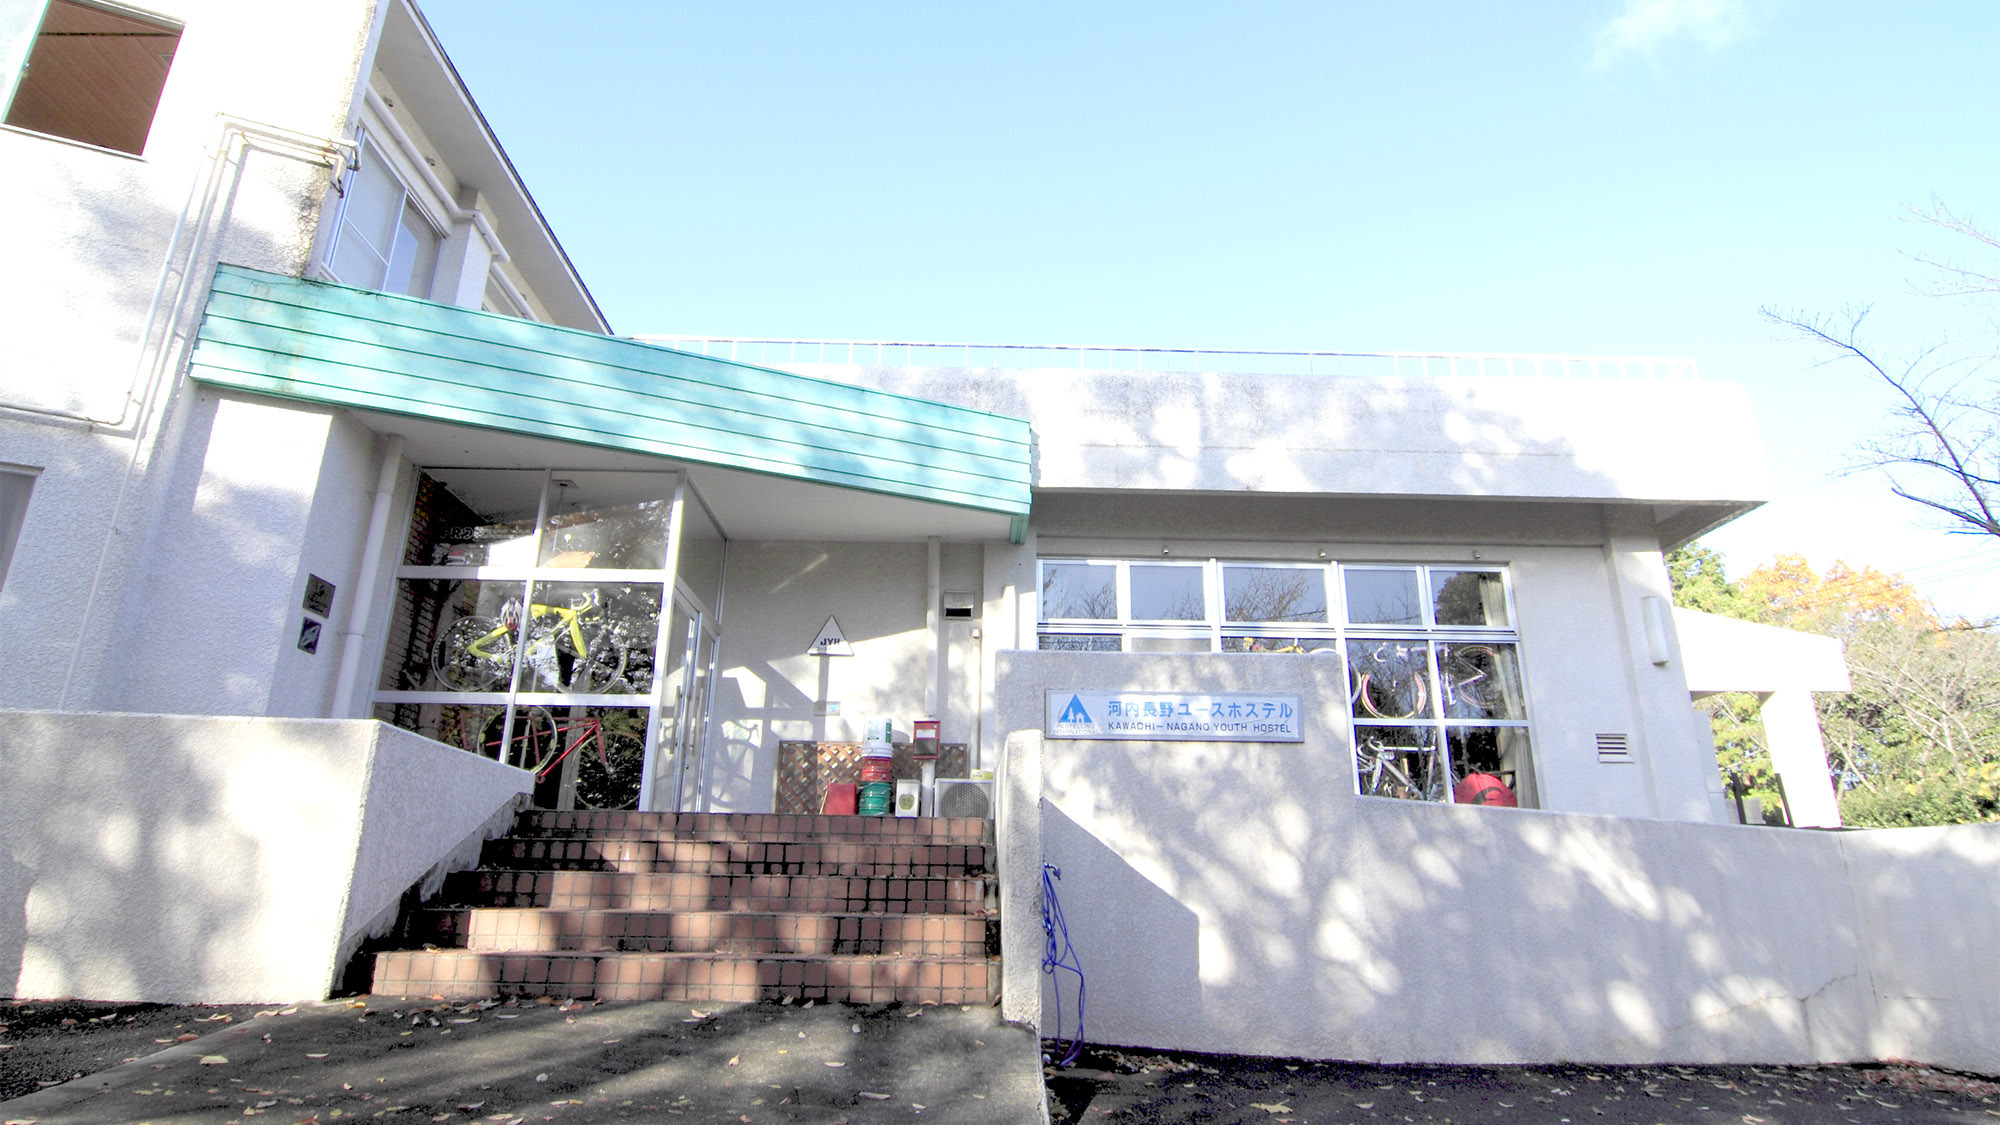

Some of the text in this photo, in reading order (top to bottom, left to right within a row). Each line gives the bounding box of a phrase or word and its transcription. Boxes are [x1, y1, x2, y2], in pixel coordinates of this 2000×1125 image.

[820, 638, 840, 646] JYH
[1108, 700, 1293, 719] 河内長野ユースホステル
[1166, 722, 1210, 731] NAGANO
[1213, 723, 1248, 732] YOUTH
[1253, 723, 1292, 733] HOSTEL
